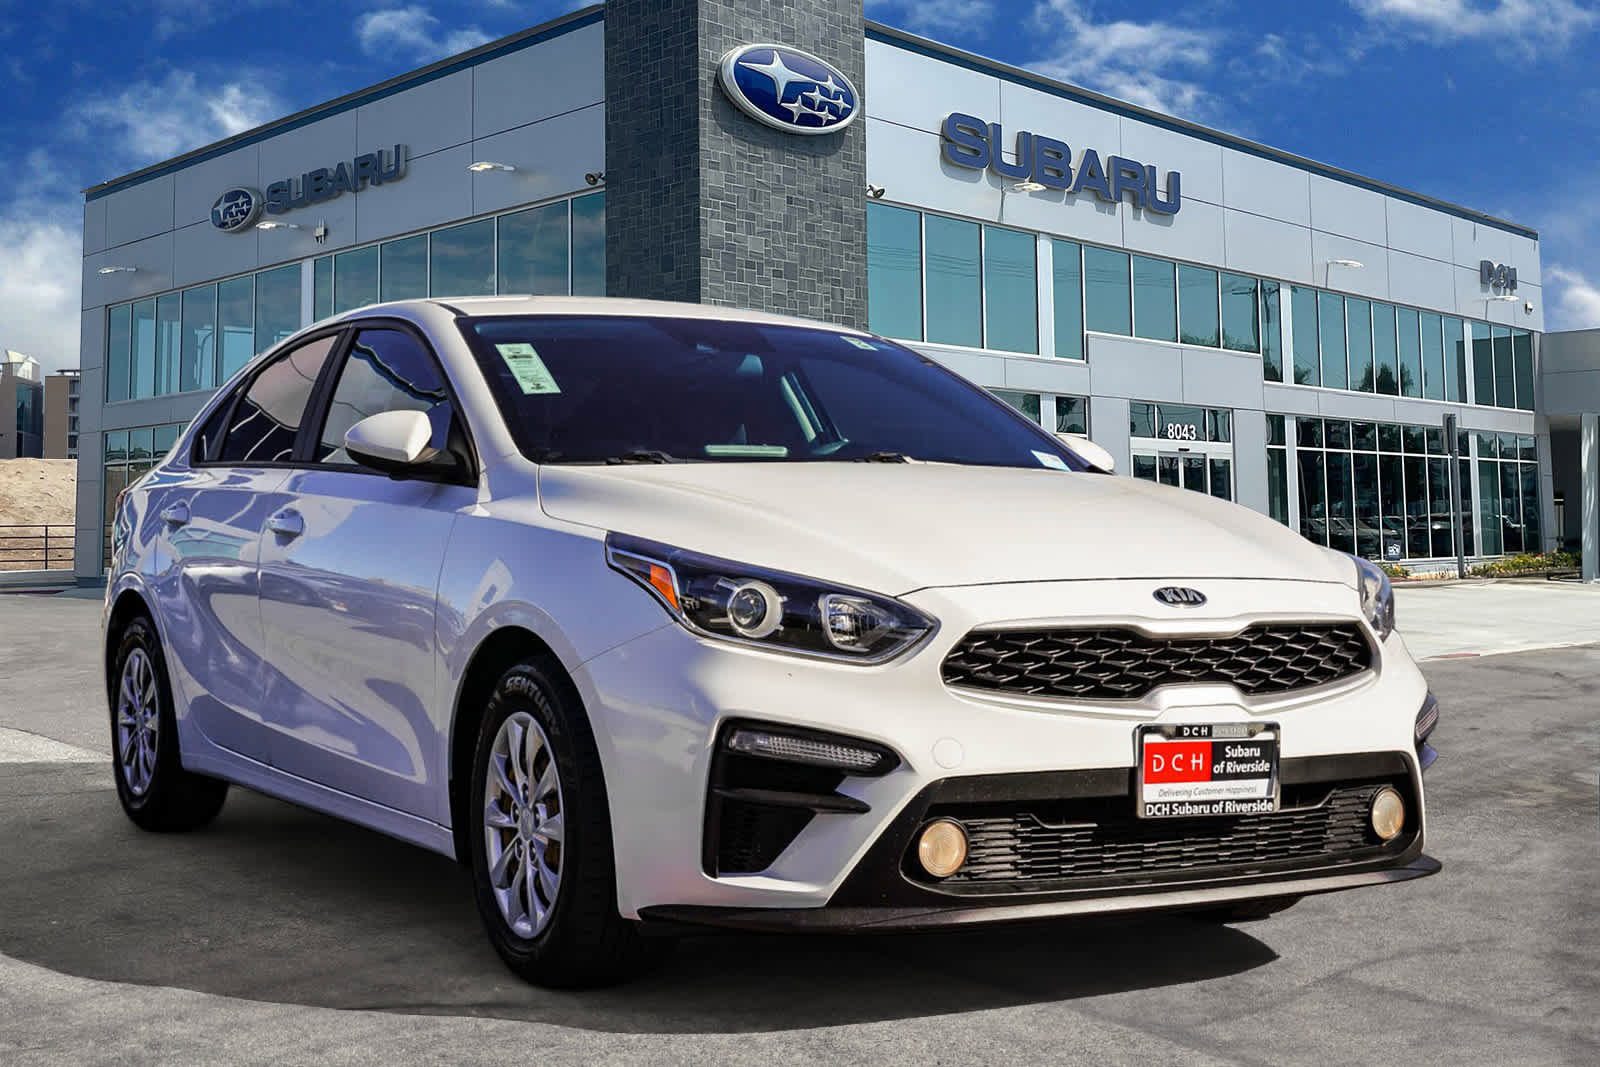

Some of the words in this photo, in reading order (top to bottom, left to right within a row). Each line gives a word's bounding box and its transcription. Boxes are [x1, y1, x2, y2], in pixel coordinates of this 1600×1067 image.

[942, 112, 1181, 215] SUBARU
[265, 144, 406, 214] SUBARU
[1167, 423, 1197, 440] 8043
[1158, 587, 1204, 603] KIA
[1224, 744, 1261, 759] Subaru
[1213, 761, 1226, 774] of
[1226, 759, 1270, 773] Riverside
[1146, 803, 1170, 816] DCH
[1171, 801, 1210, 815] Subaru
[1210, 801, 1224, 814] of
[1225, 799, 1273, 813] Riverside
